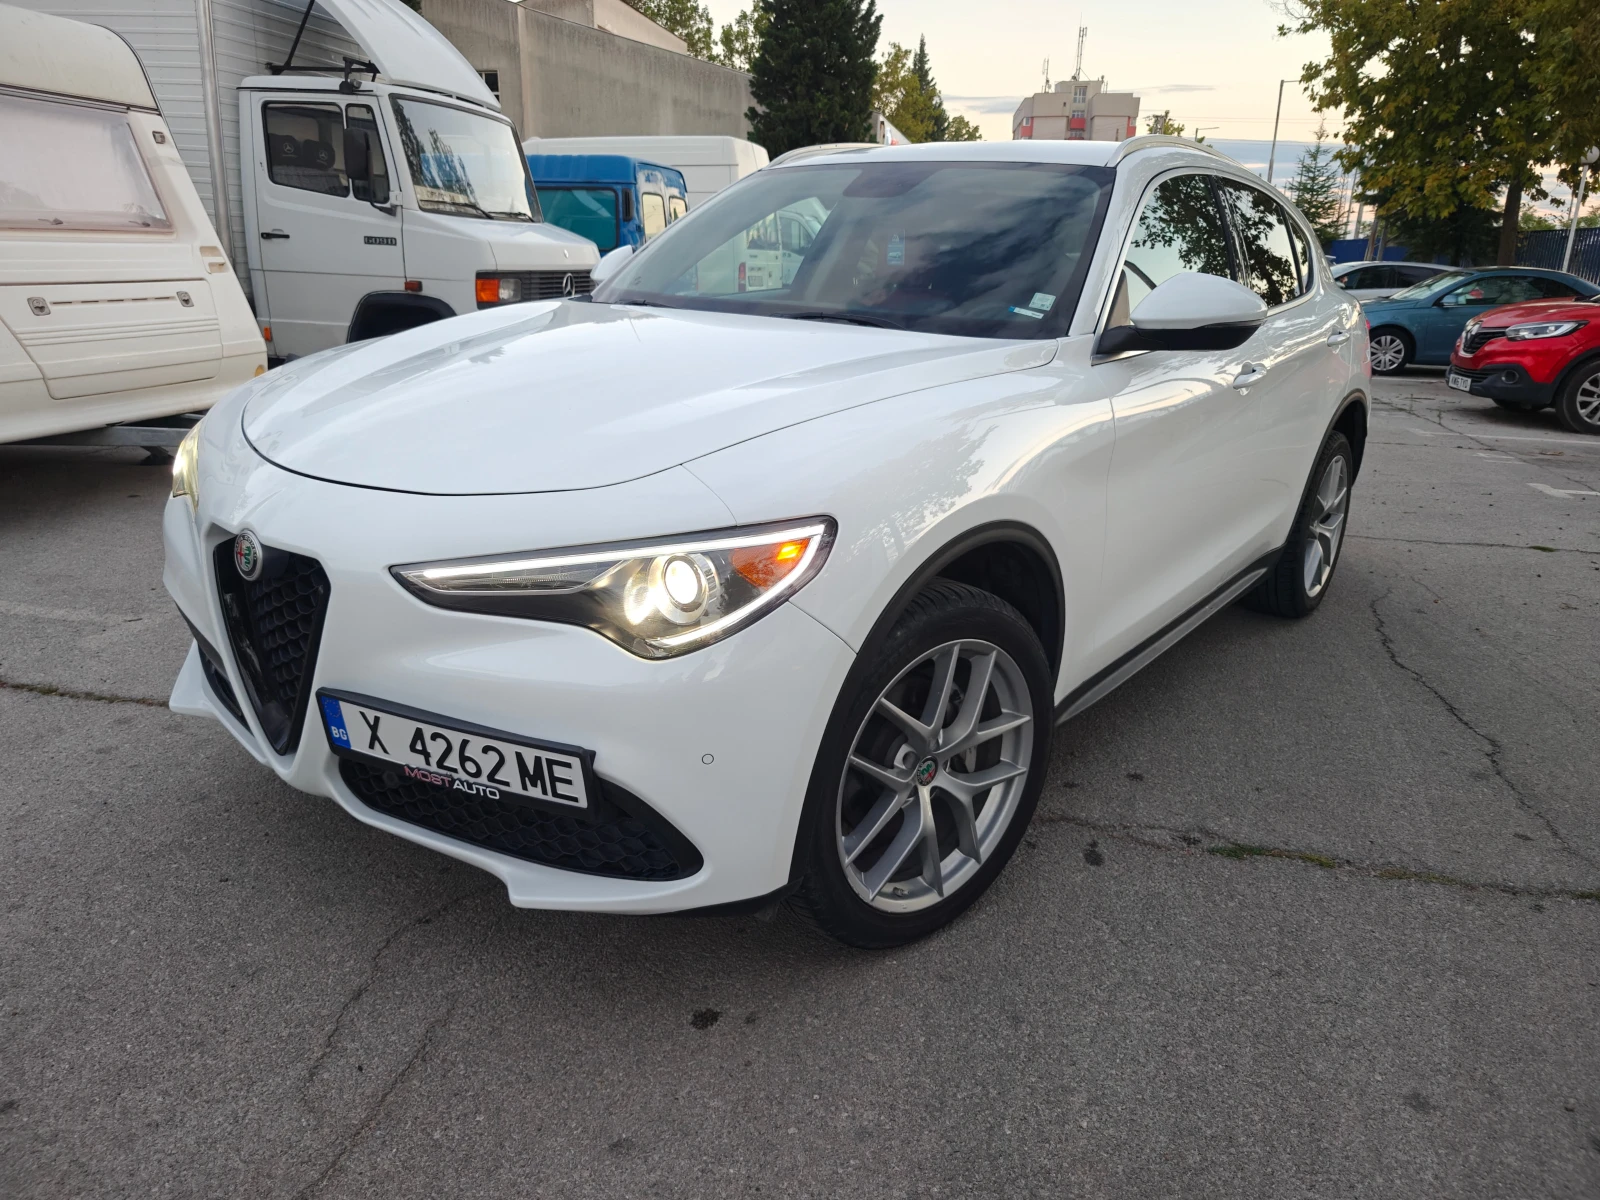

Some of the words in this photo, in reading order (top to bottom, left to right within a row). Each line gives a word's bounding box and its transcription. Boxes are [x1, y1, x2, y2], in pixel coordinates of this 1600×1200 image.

[331, 726, 348, 740] BG
[359, 710, 390, 755] X
[404, 765, 452, 787] MOST
[453, 780, 500, 800] AUTO
